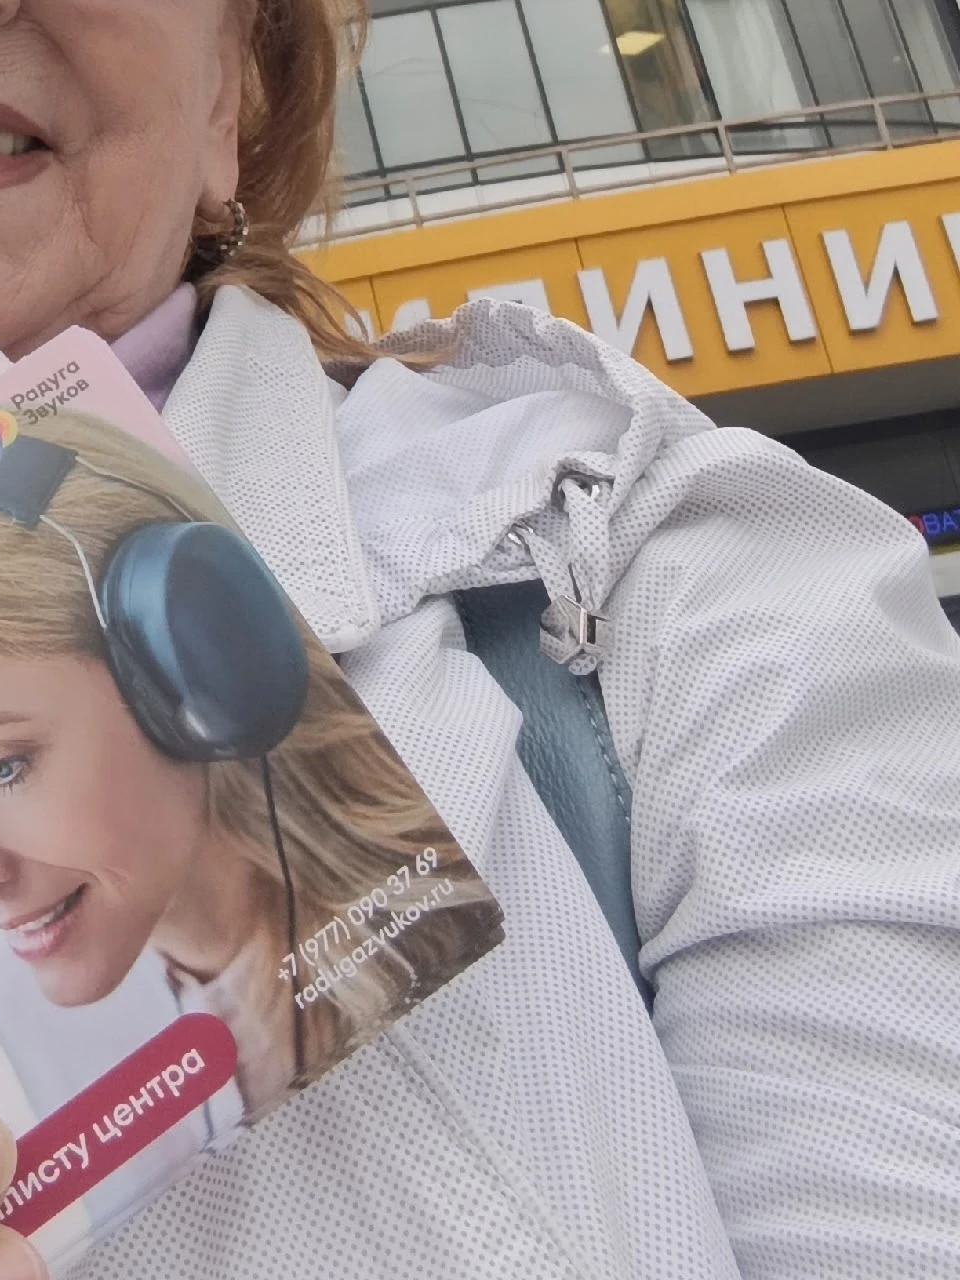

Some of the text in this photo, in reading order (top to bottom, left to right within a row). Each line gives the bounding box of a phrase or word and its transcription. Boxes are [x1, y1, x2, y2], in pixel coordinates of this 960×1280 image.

[10, 360, 80, 409] Радуга
[23, 379, 89, 424] Звуков
[278, 847, 438, 981] +7 (977) 090 37 69
[294, 878, 454, 1009] radugazvukov.ru
[92, 1048, 205, 1143] центра
